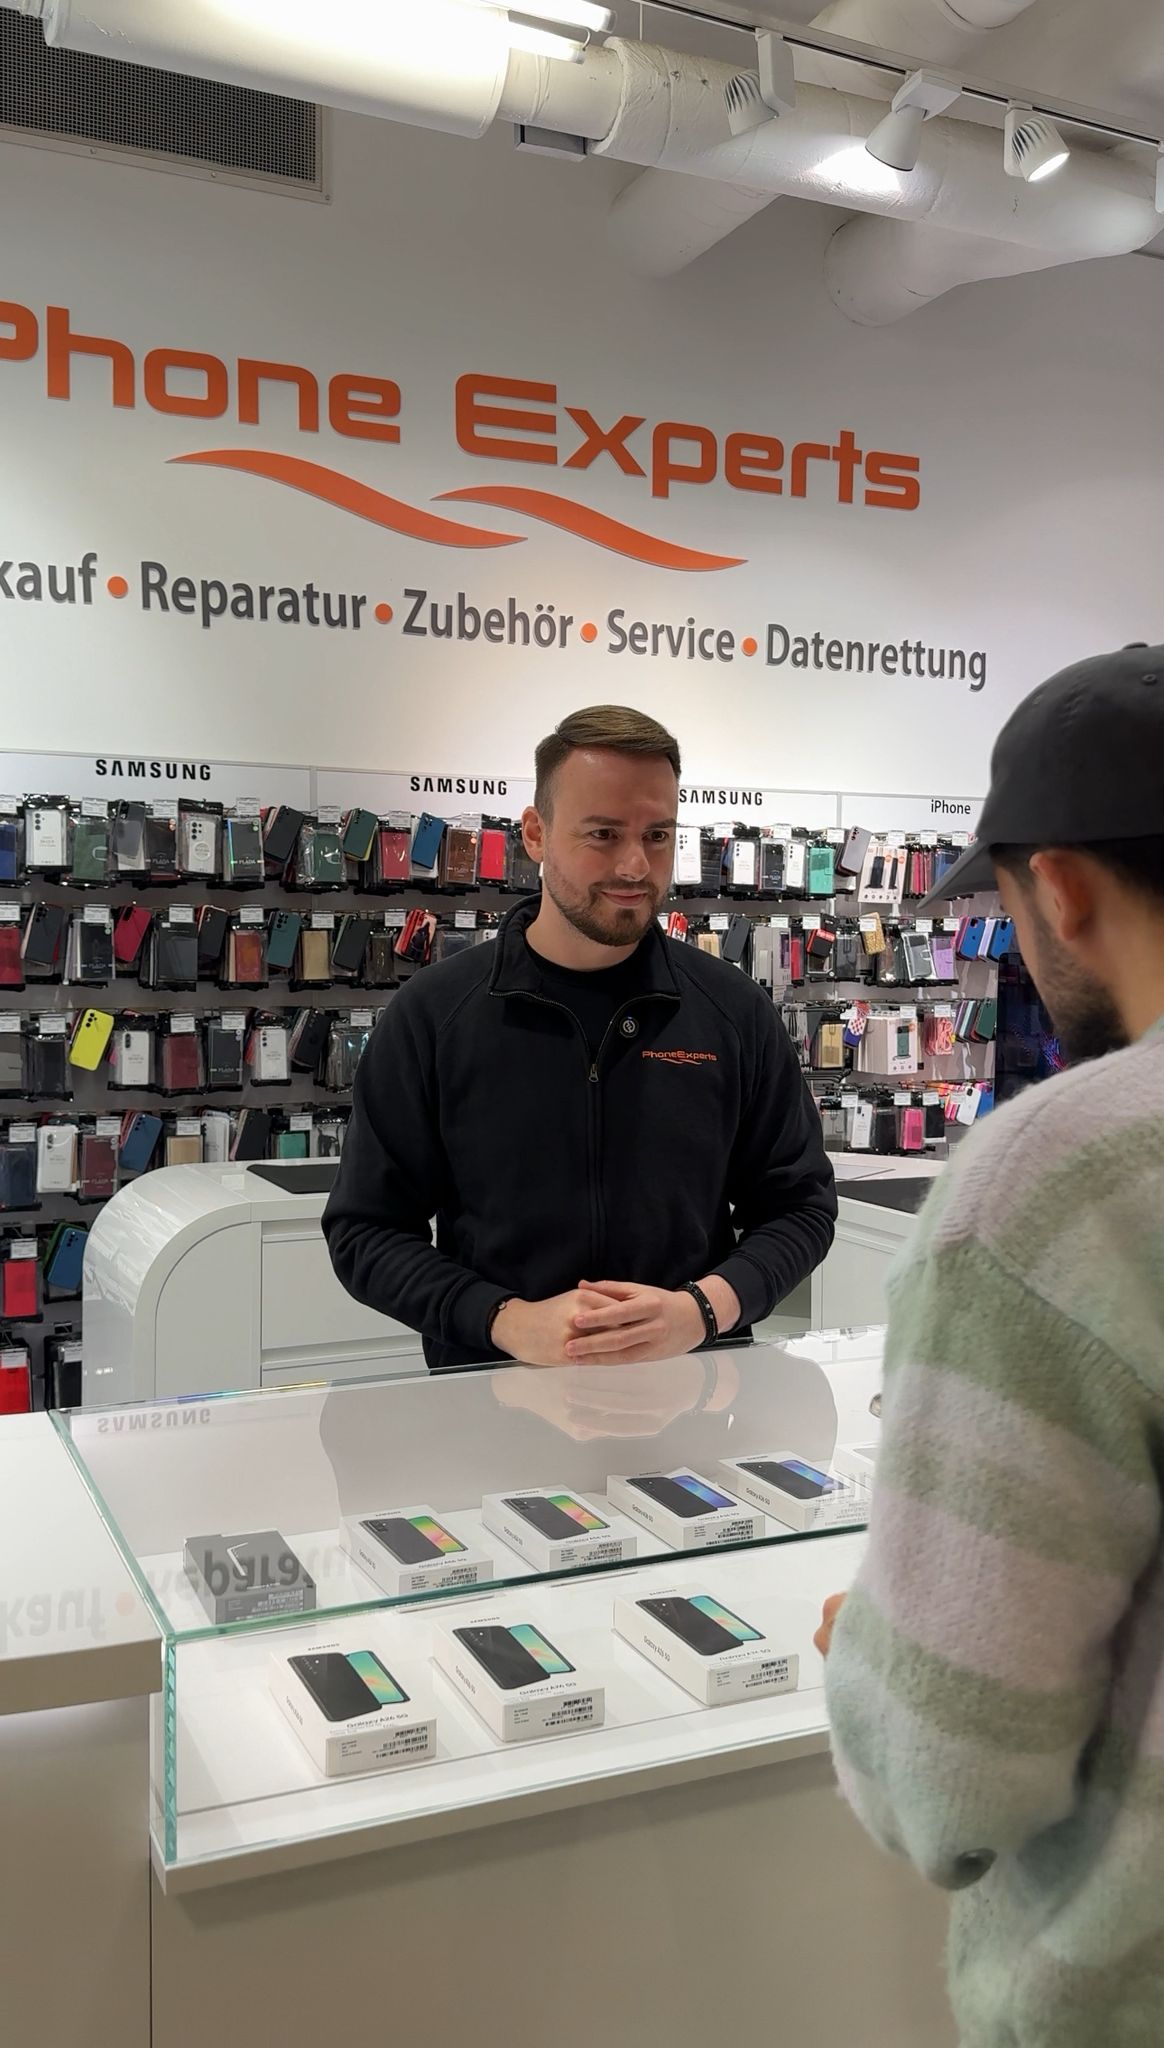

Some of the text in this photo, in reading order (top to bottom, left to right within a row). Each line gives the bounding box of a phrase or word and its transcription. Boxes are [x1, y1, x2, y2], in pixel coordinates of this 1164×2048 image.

[455, 373, 920, 511] Experts
[140, 560, 367, 628] Reparatur
[402, 588, 573, 650] Zubehör
[607, 609, 736, 663] Service
[766, 623, 987, 692] Datenrettung
[95, 759, 211, 781] SAMSUNG
[410, 776, 508, 796] SAMSUNG
[679, 788, 763, 806] SAMSUNG
[930, 799, 971, 815] iPhone
[642, 1050, 718, 1062] PhoneExperts
